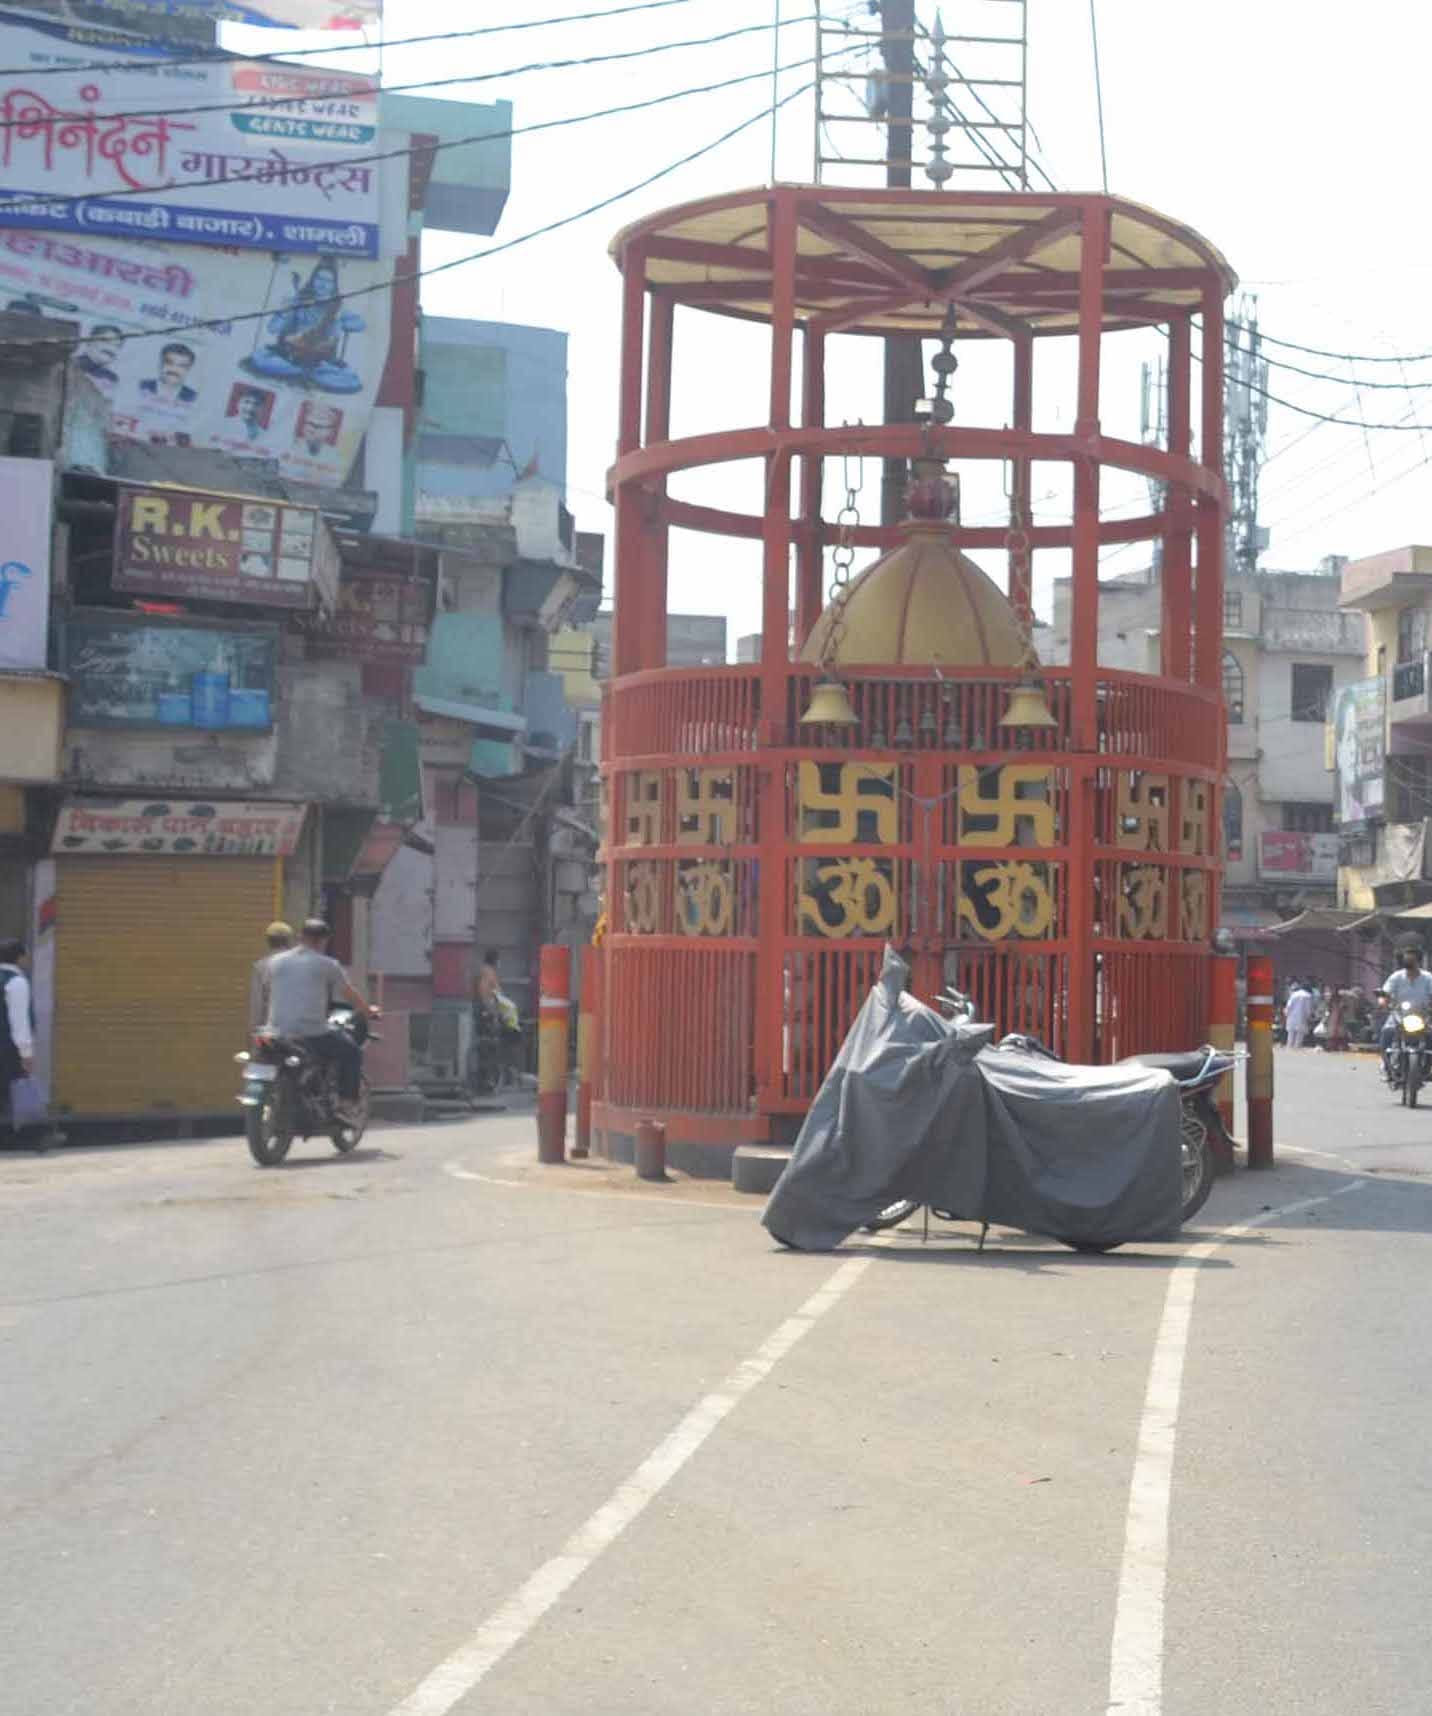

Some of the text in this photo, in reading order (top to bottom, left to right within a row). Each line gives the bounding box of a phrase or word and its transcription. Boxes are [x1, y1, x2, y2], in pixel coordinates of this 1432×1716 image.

[0, 84, 196, 190] भिनंदन
[131, 496, 240, 542] R.K.
[131, 535, 230, 568] Sweets
